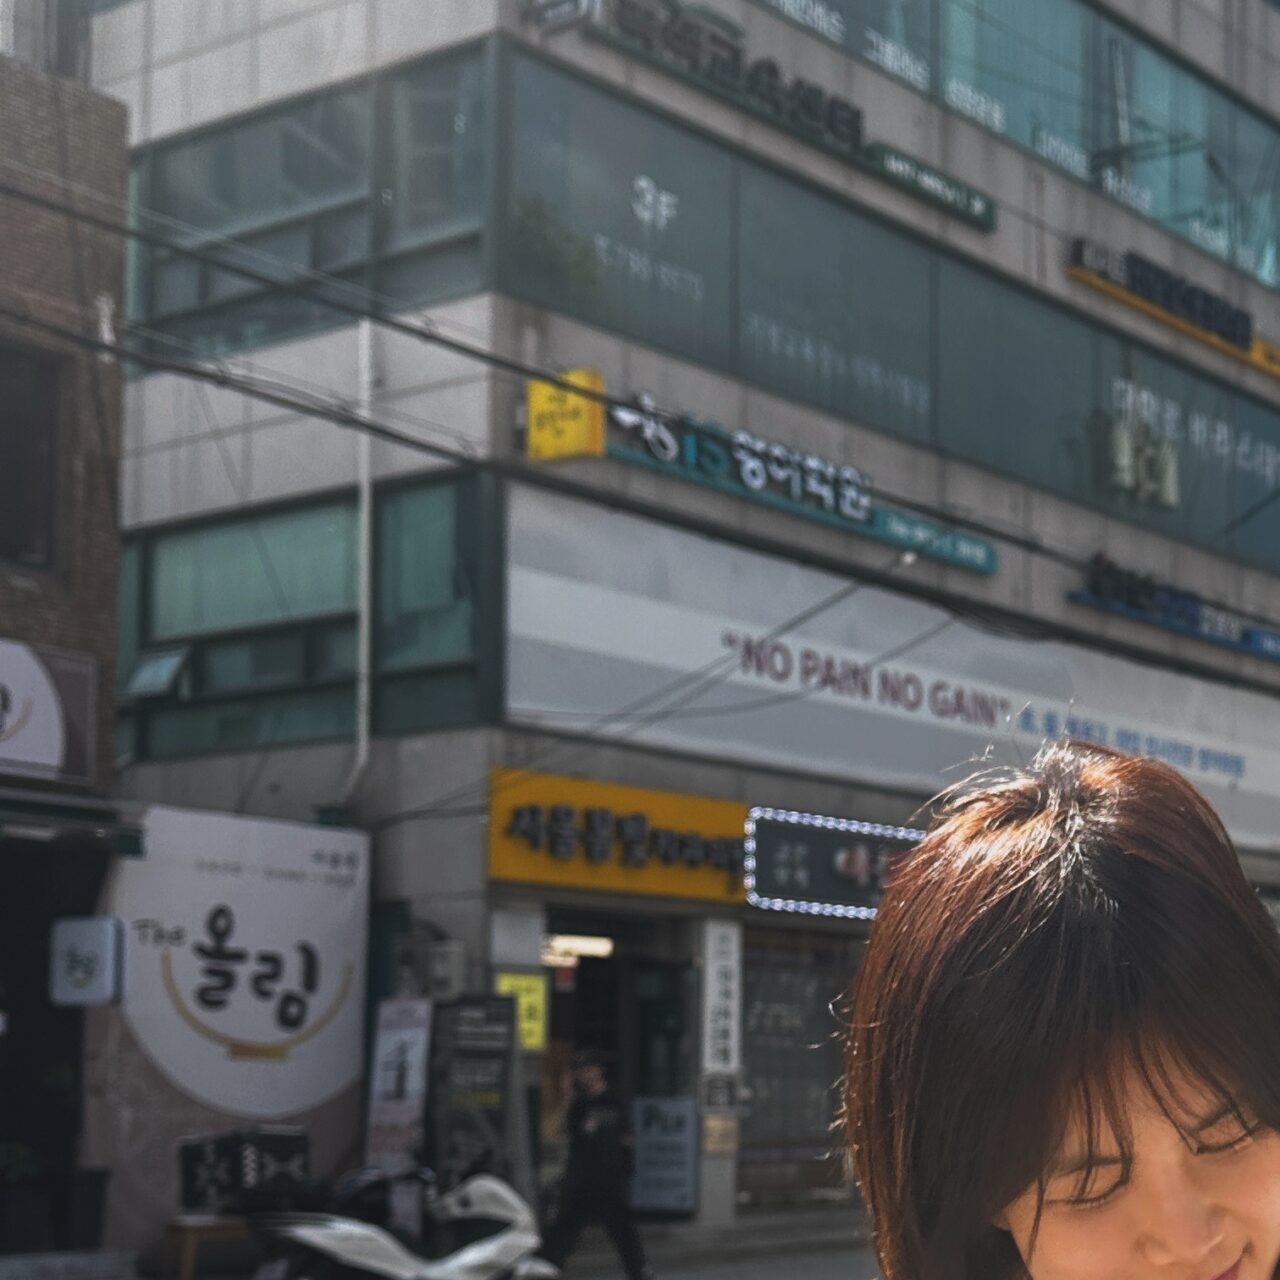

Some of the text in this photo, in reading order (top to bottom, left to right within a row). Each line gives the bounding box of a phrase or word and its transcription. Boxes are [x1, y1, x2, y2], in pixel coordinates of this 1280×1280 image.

[800, 649, 873, 700] PAIN
[877, 667, 924, 713] NO
[131, 917, 187, 947] The
[192, 902, 320, 1033] 올링
